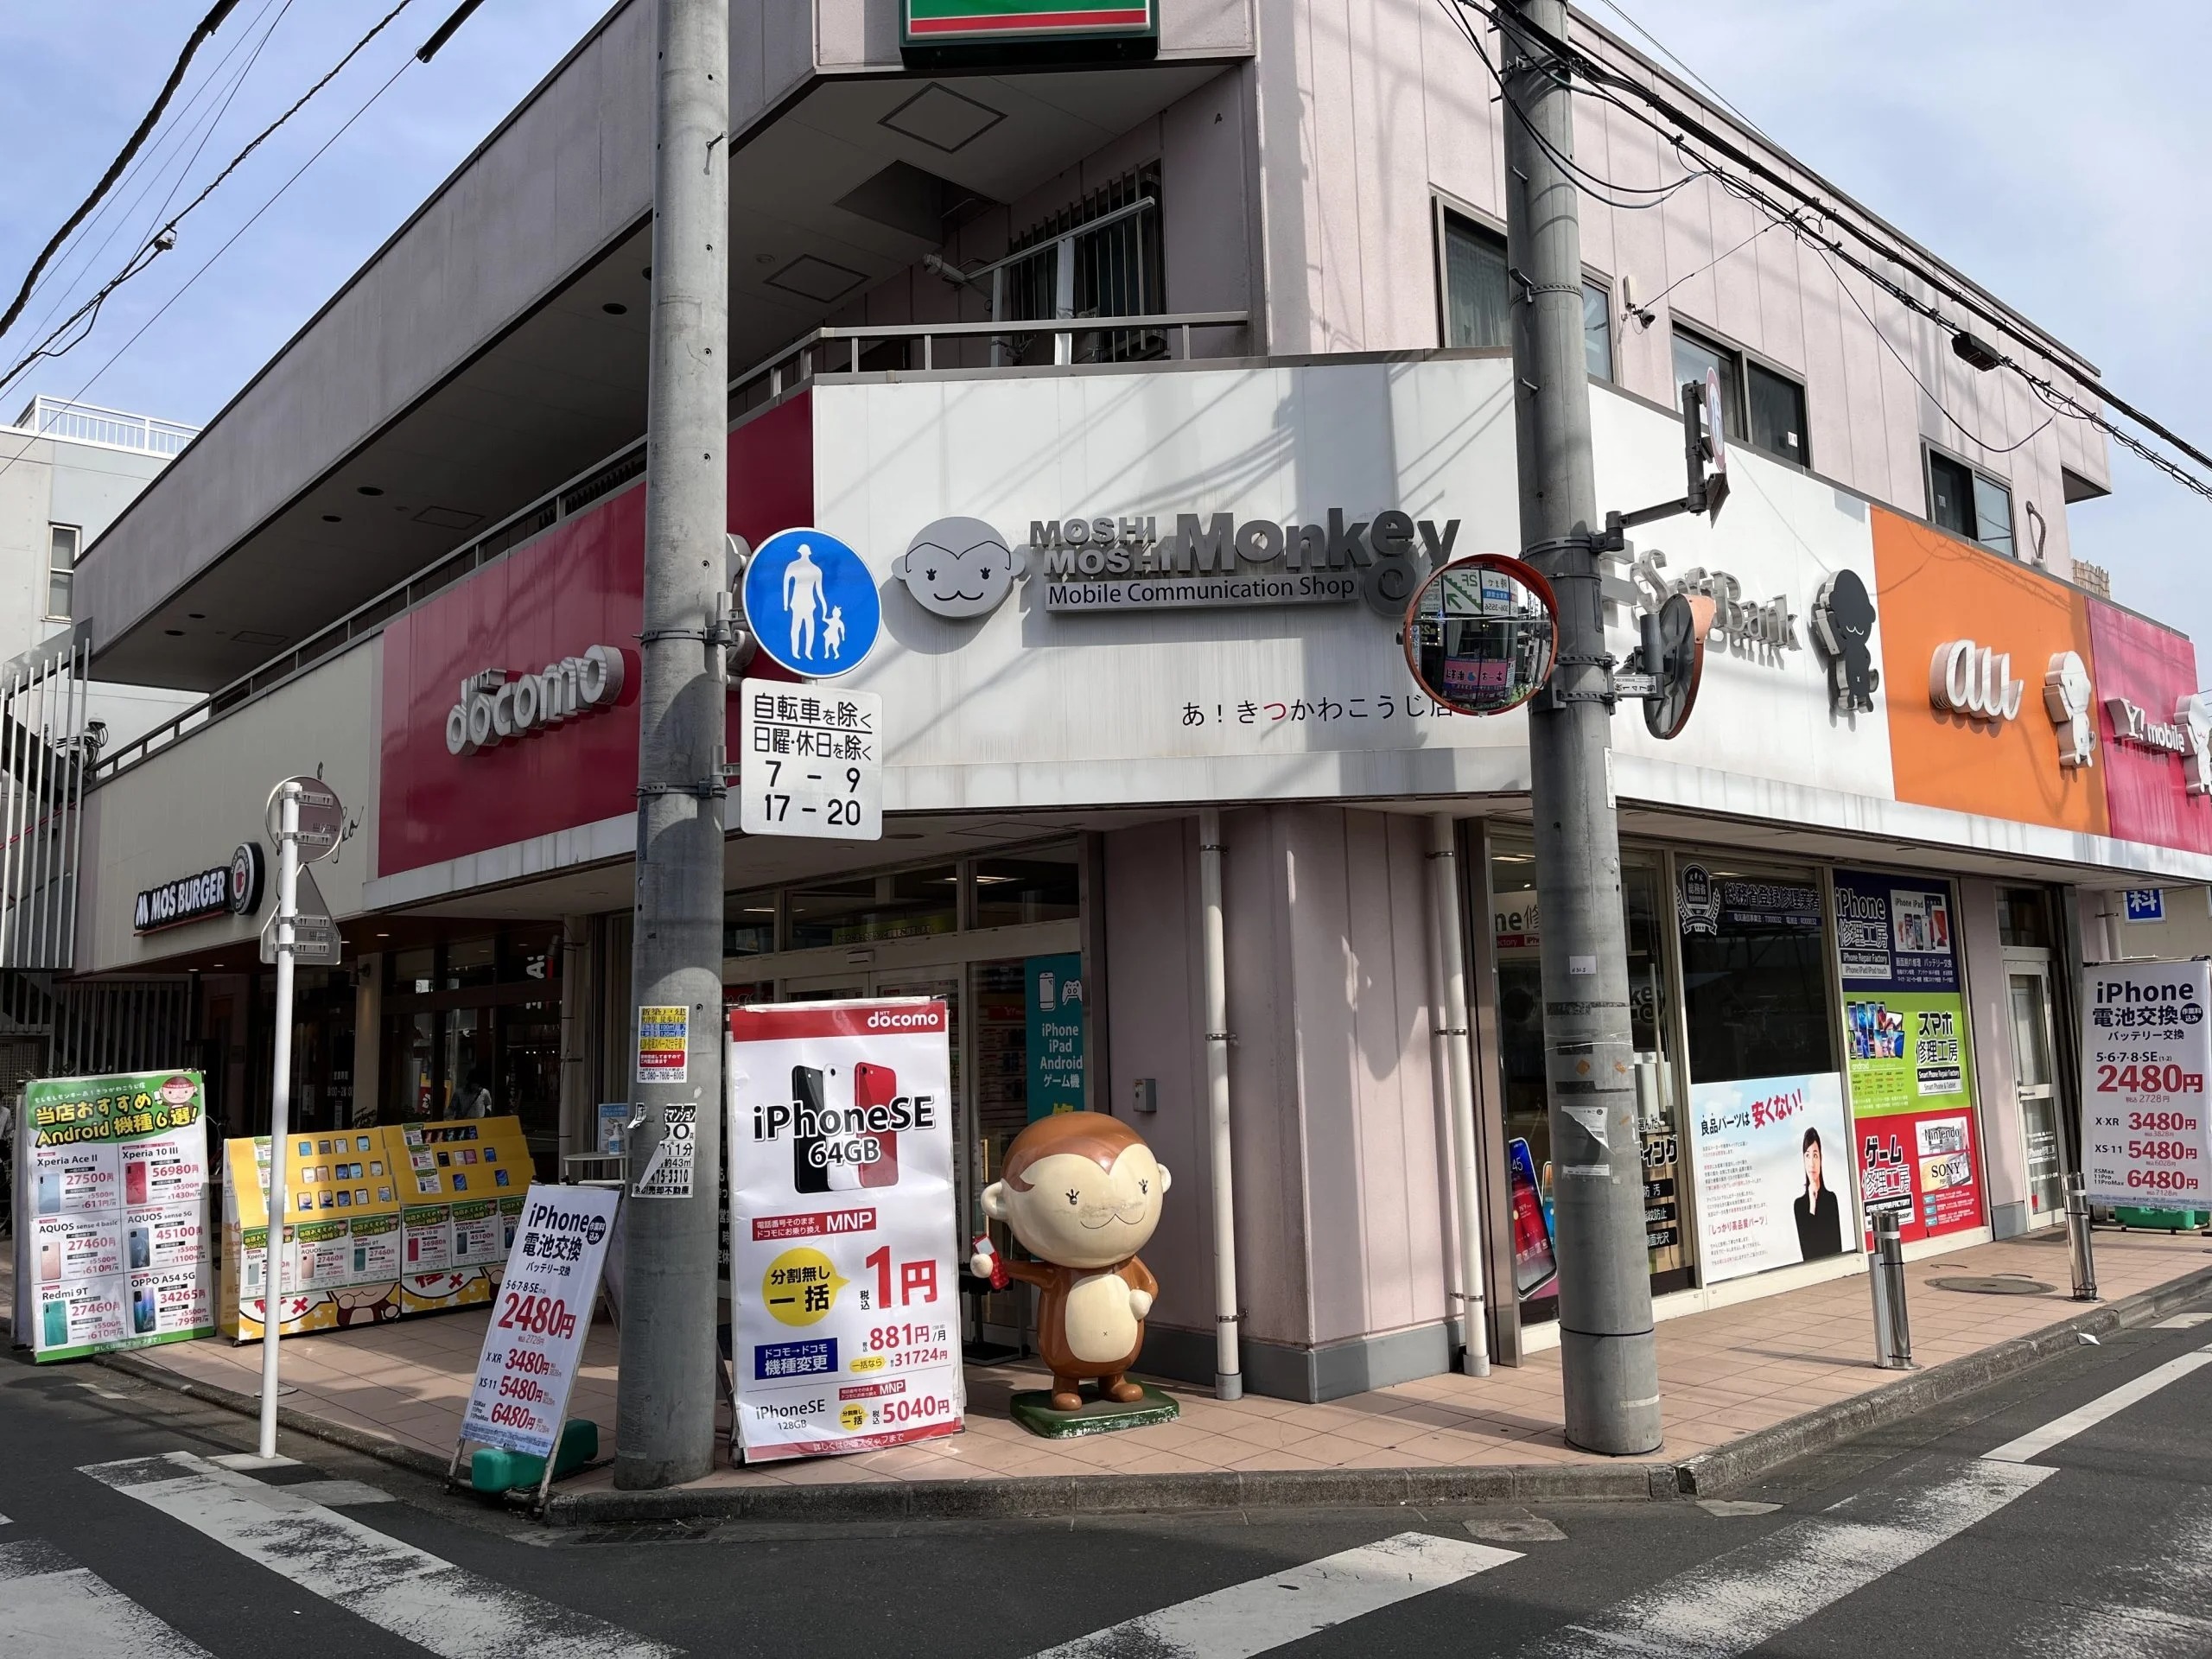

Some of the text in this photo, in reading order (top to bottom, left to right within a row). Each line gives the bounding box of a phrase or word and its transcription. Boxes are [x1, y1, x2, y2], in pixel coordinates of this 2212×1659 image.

[1030, 516, 1156, 546] MOSHI
[1043, 507, 1460, 575] MOSHI Monkey
[1048, 575, 1355, 607] Mobile Communication Shop
[1932, 639, 2024, 721] au
[446, 644, 624, 756] docomo
[753, 692, 872, 729] 自転車を除く
[753, 726, 872, 761] 日曜・休日を除く
[150, 870, 226, 920] MOS BURGER
[1835, 887, 1886, 920] iPhone
[1838, 920, 1888, 950] 修理工房
[2097, 981, 2194, 1003] iPhone
[868, 1012, 938, 1028] docomo
[1918, 1011, 1954, 1037] スマホ
[2093, 1005, 2178, 1027] 電池交換
[1042, 1023, 1079, 1037] iPhone
[2108, 1029, 2184, 1041] バッテリー交換
[1049, 1039, 1072, 1052] iPad
[1916, 1039, 1958, 1065] 修理工房
[1039, 1056, 1083, 1070] Android
[1044, 1075, 1080, 1088] ゲーム機
[2096, 1065, 2203, 1093] 2480円
[36, 1092, 152, 1125] 当店おすすめ
[753, 1095, 935, 1141] iPhoneSE
[1700, 1111, 1751, 1137] 良品パーツは
[2128, 1112, 2196, 1130] 3480円
[36, 1121, 110, 1147] Android
[1925, 1125, 1960, 1141] Nintendo
[37, 1156, 69, 1166] Xperia
[123, 1149, 153, 1160] Xperia
[808, 1138, 880, 1167] 64GB
[1866, 1135, 1904, 1167] ゲーム
[2128, 1141, 2197, 1160] 5480円
[66, 1173, 114, 1185] 27500円
[153, 1165, 199, 1177] 56980円
[1931, 1162, 1960, 1178] SONY
[2127, 1169, 2198, 1190] 6480円
[1861, 1165, 1911, 1199] 修理工房
[39, 1223, 74, 1234] AQUOS
[127, 1212, 162, 1224] AQUOS
[528, 1203, 589, 1233] iPhone
[757, 1217, 816, 1230] 電話番号そのまま
[757, 1211, 873, 1238] ドコモにお乗り換え MNP
[68, 1237, 116, 1251] 27460円
[156, 1226, 203, 1240] 45100円
[523, 1231, 582, 1262] 電池交換
[131, 1272, 195, 1287] OPPO A54 5G
[525, 1262, 571, 1277] バッテリー交換
[771, 1266, 830, 1286] 分割無し
[866, 1245, 938, 1309] 1円
[42, 1287, 88, 1300] Redmi 9T
[160, 1289, 206, 1304] 34265円
[73, 1301, 120, 1317] 27460円
[498, 1292, 576, 1339] 2480円
[505, 1348, 550, 1376] 3480円
[765, 1355, 828, 1376] 機種変更
[852, 1348, 948, 1370] 一括なら 31724円
[499, 1375, 543, 1403] 5480円
[880, 1382, 904, 1395] MNP
[491, 1402, 536, 1430] 6480円
[756, 1399, 826, 1420] iPhoneSE
[883, 1395, 950, 1424] 5040円
[778, 1420, 807, 1430] 128GB
